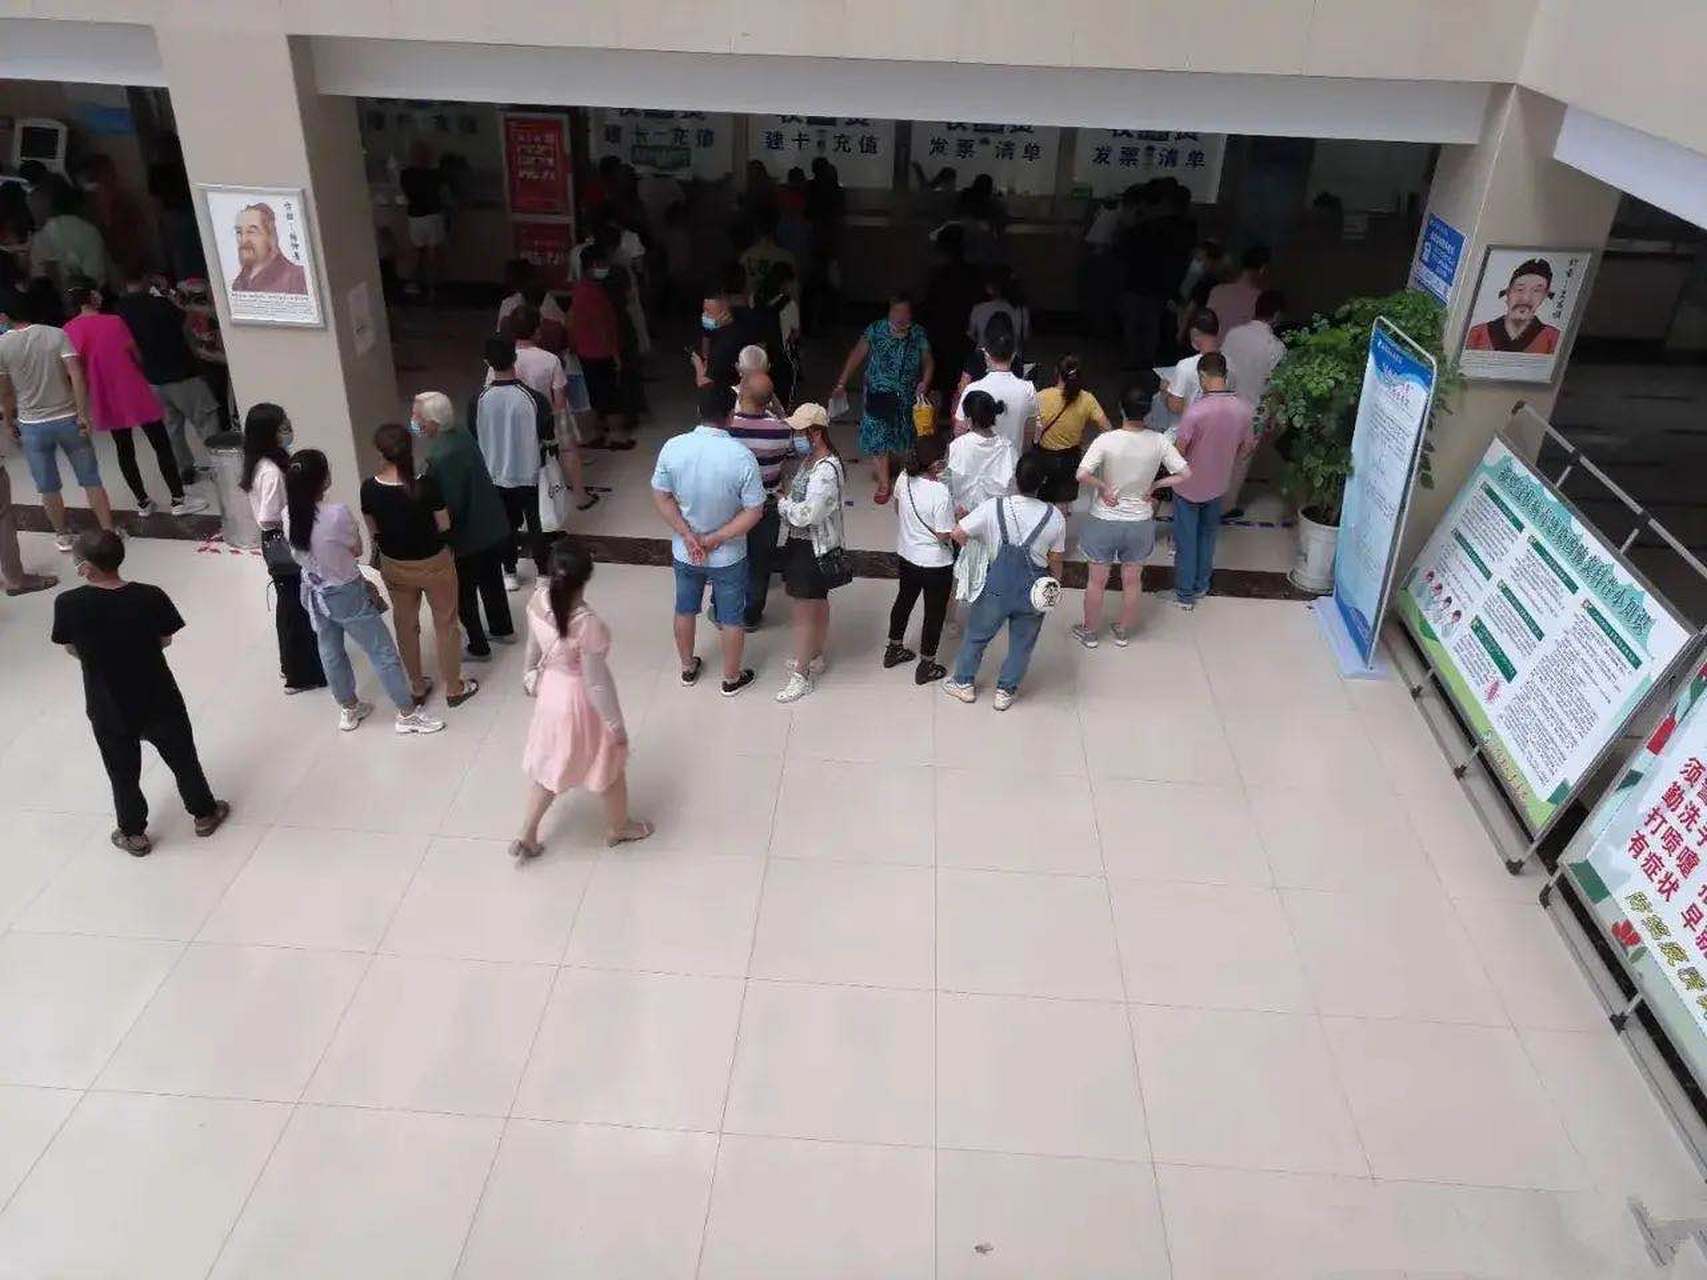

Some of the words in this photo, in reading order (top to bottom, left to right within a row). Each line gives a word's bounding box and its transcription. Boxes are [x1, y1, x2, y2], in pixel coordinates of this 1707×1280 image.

[833, 133, 879, 155] 充值
[928, 136, 977, 160] 发票
[995, 140, 1041, 162] 清单
[1091, 144, 1140, 168] 发票
[1159, 147, 1206, 170] 清单
[1645, 806, 1700, 879] 打喷嚏
[1628, 830, 1680, 902] 有症状
